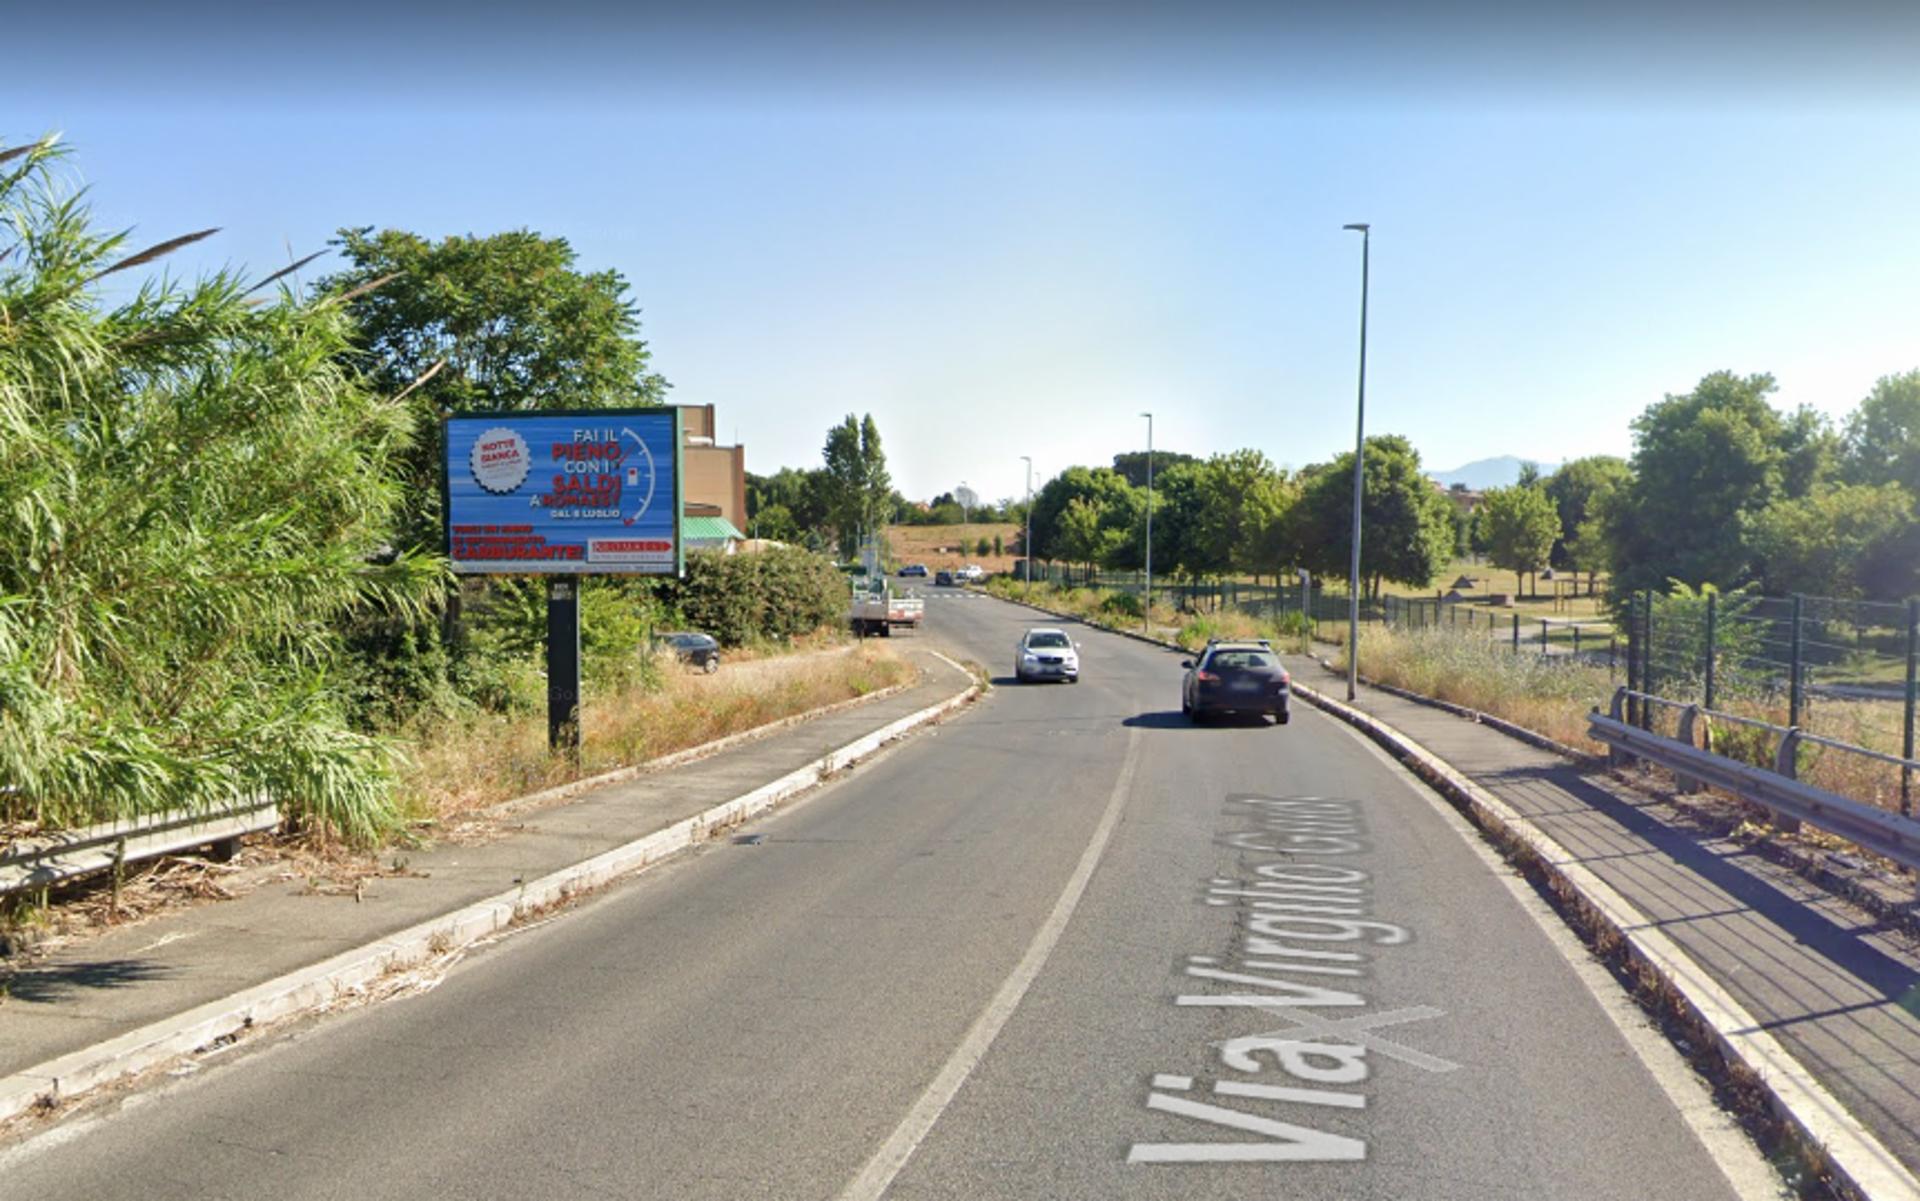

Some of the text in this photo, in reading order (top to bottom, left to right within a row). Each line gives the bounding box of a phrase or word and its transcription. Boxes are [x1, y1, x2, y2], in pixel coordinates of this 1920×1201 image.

[574, 430, 618, 442] FAI IL
[552, 442, 621, 460] PIENO
[564, 461, 599, 473] CON
[529, 494, 541, 507] A
